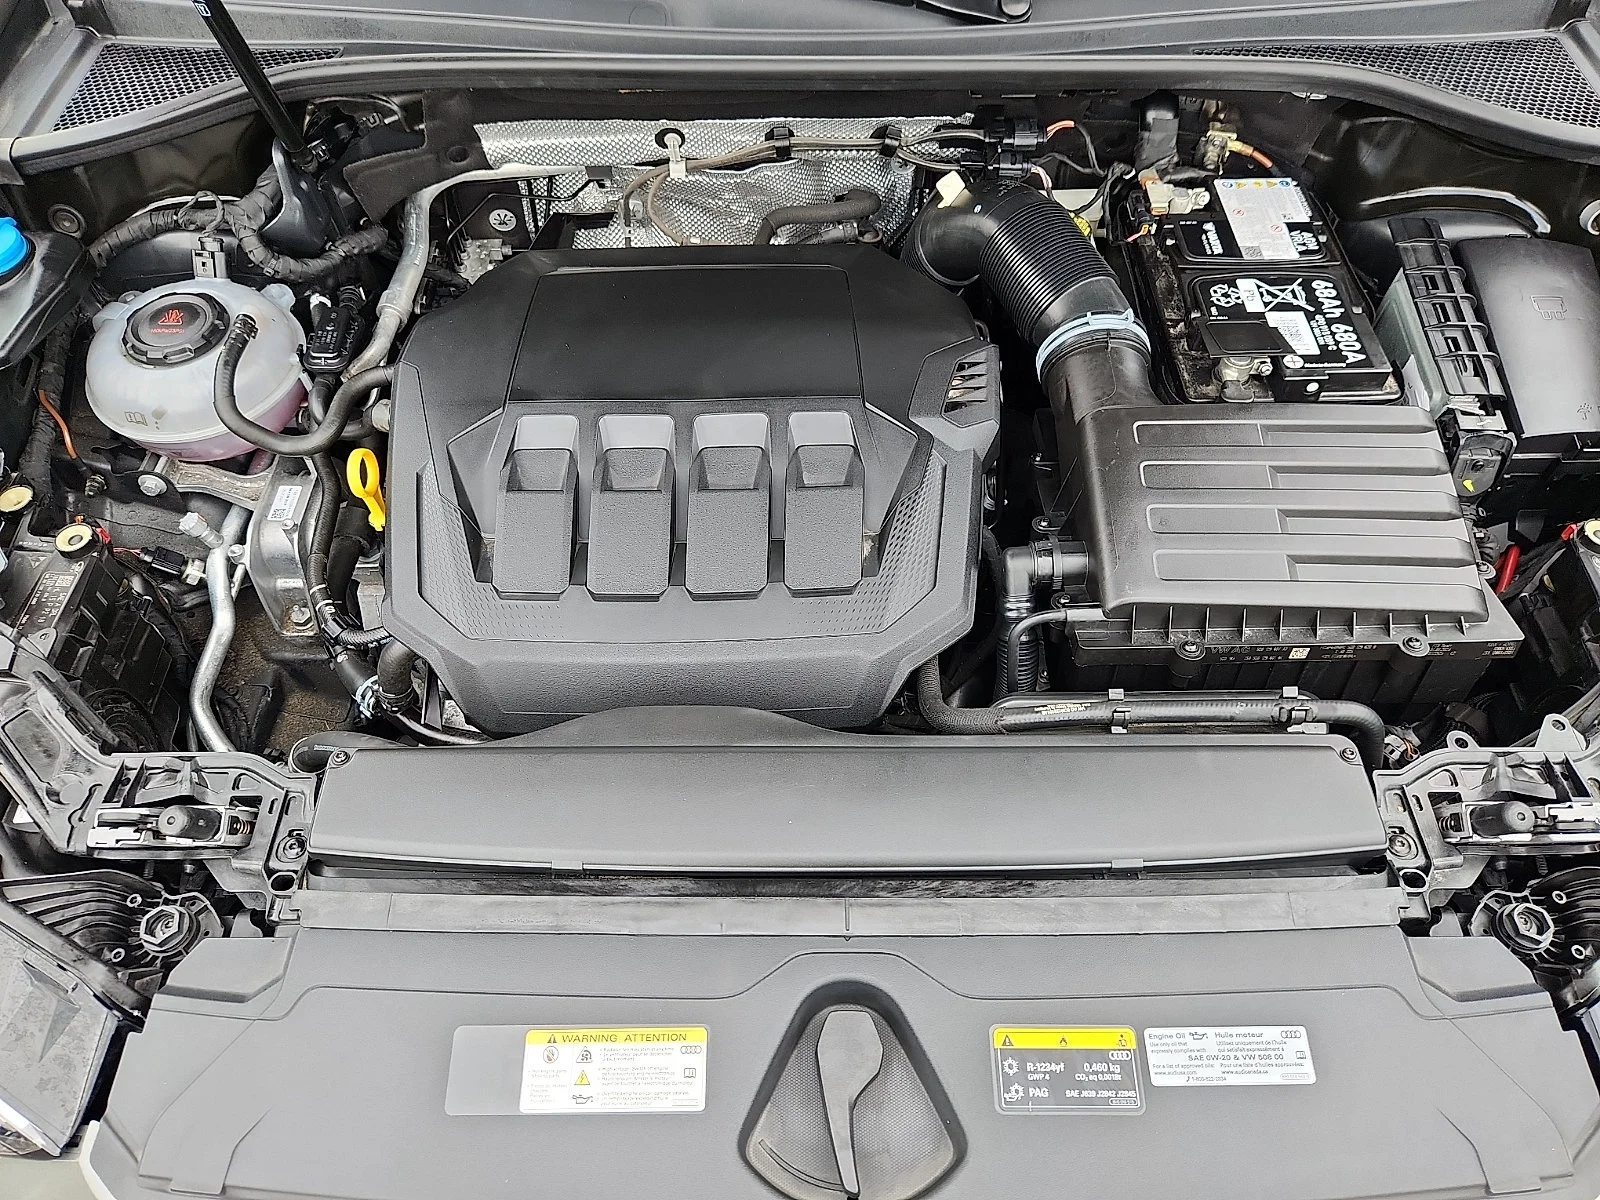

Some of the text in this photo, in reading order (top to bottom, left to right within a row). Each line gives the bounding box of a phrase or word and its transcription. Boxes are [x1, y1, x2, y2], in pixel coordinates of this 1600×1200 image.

[1289, 230, 1308, 252] VRLA
[1300, 232, 1320, 250] AGM
[1311, 280, 1346, 318] 68Ah
[1332, 322, 1366, 364] 680A
[562, 1033, 687, 1043] WARNING ATTENTION
[1027, 1062, 1120, 1073] R-1234yf 0,460 kg
[1029, 1087, 1048, 1097] PAG
